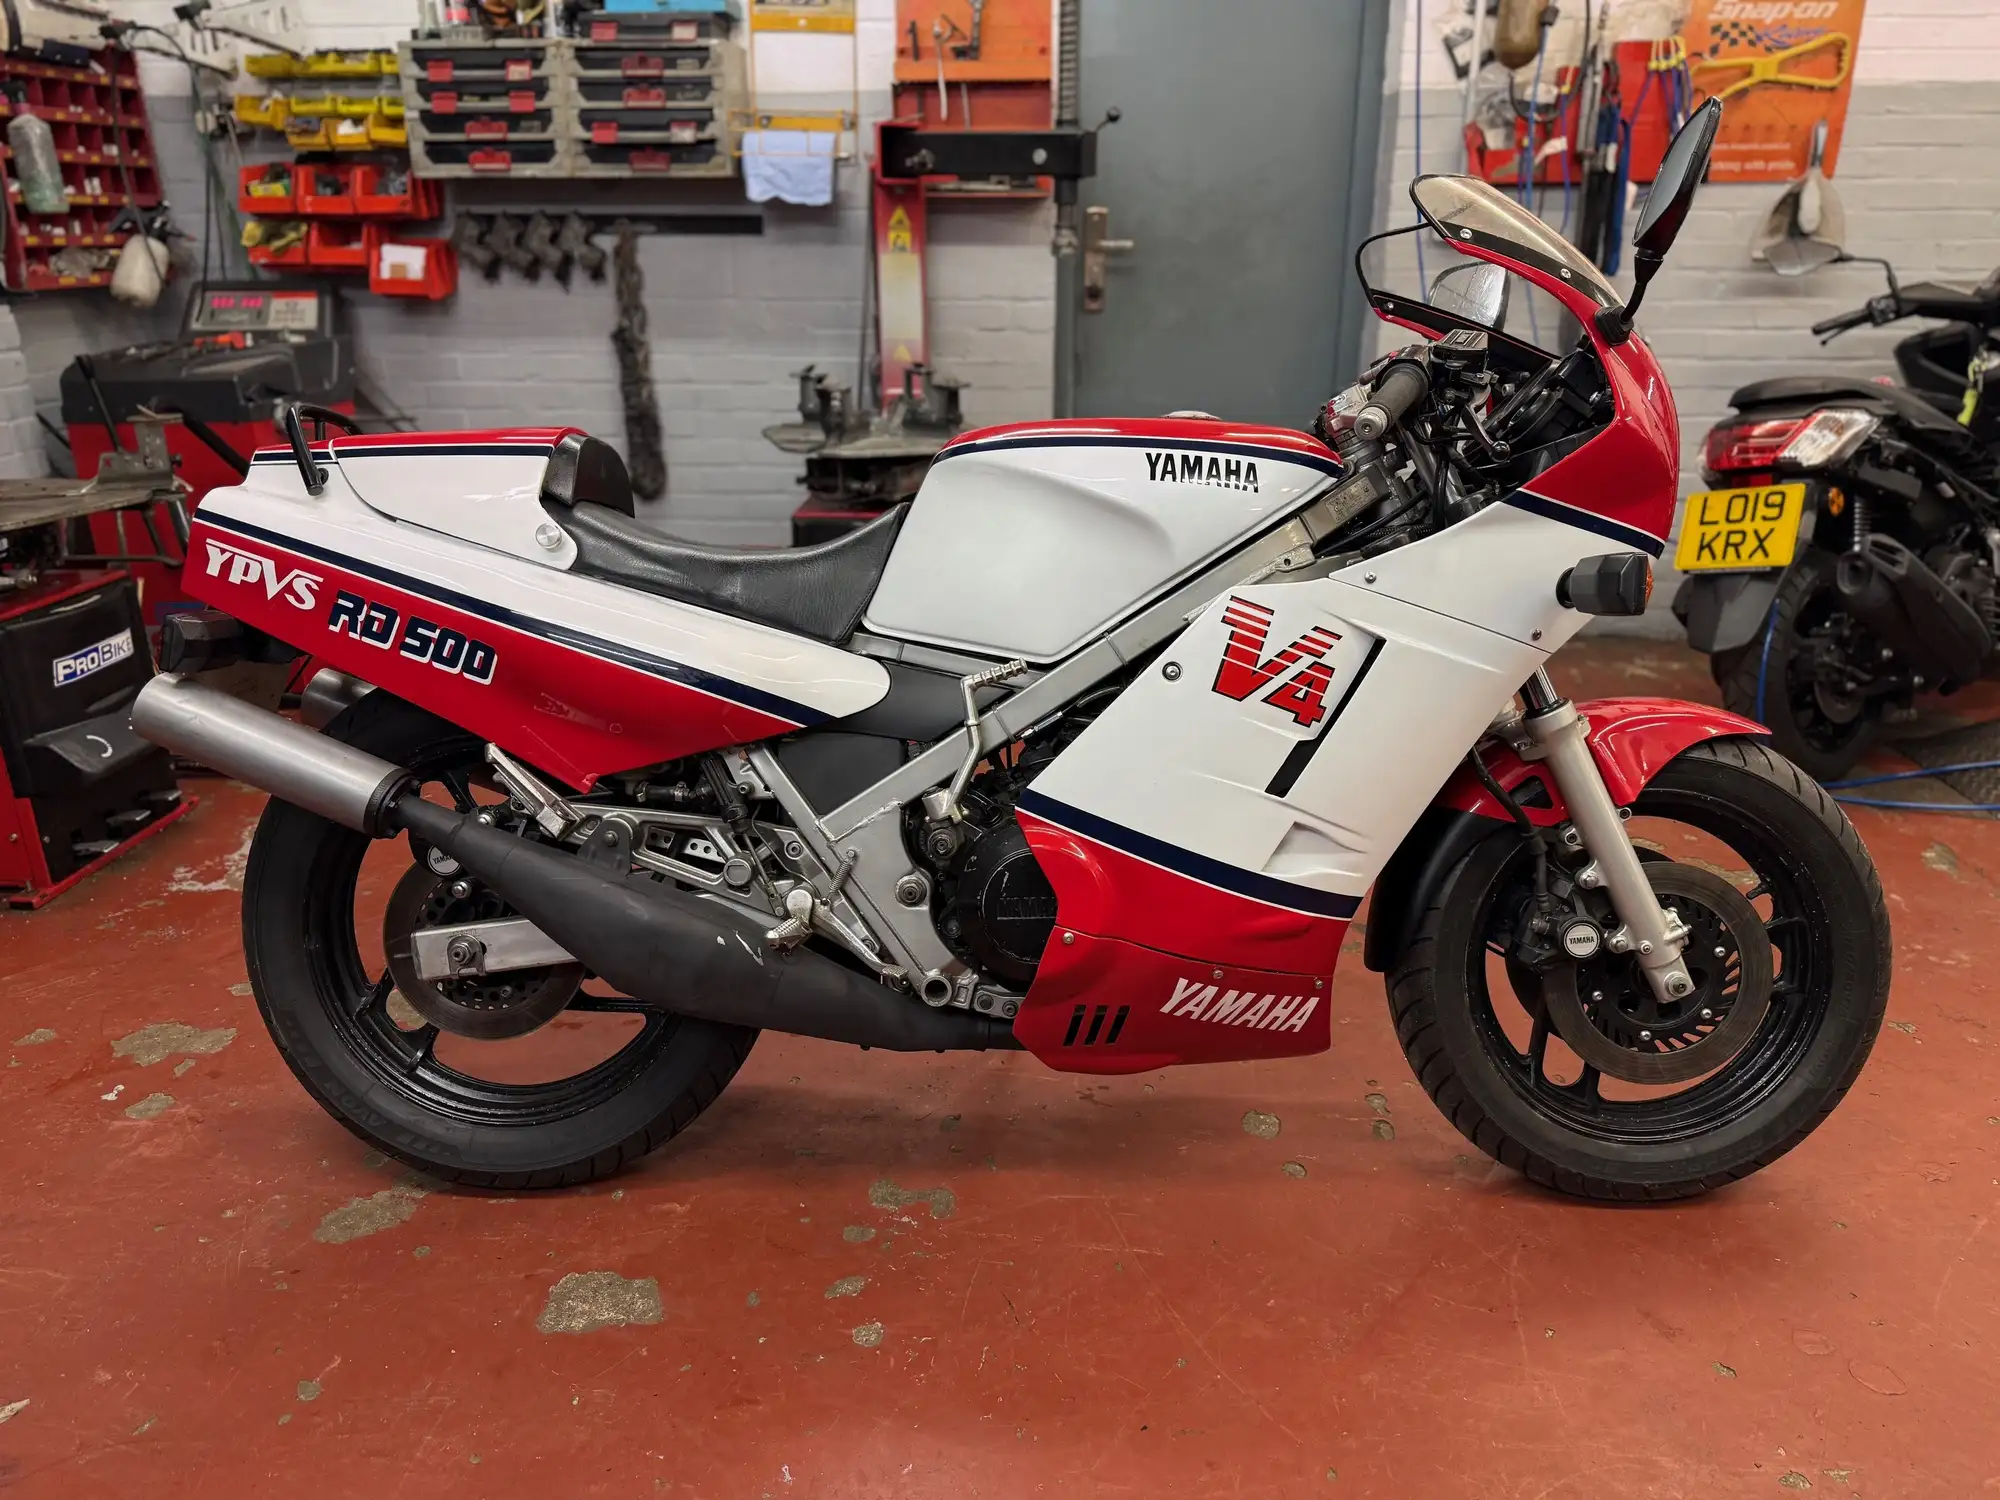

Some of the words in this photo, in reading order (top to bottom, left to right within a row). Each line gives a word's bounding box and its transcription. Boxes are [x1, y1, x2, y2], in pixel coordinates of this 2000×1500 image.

[1145, 452, 1259, 493] YAMAHA
[1699, 491, 1786, 526] LO19
[1696, 528, 1775, 561] KRX
[205, 538, 324, 611] YPVS
[328, 588, 401, 650] RD
[399, 615, 498, 686] 500
[1211, 594, 1343, 728] V4
[1568, 935, 1595, 945] YAMAHA
[1159, 977, 1320, 1033] YAMAHA
